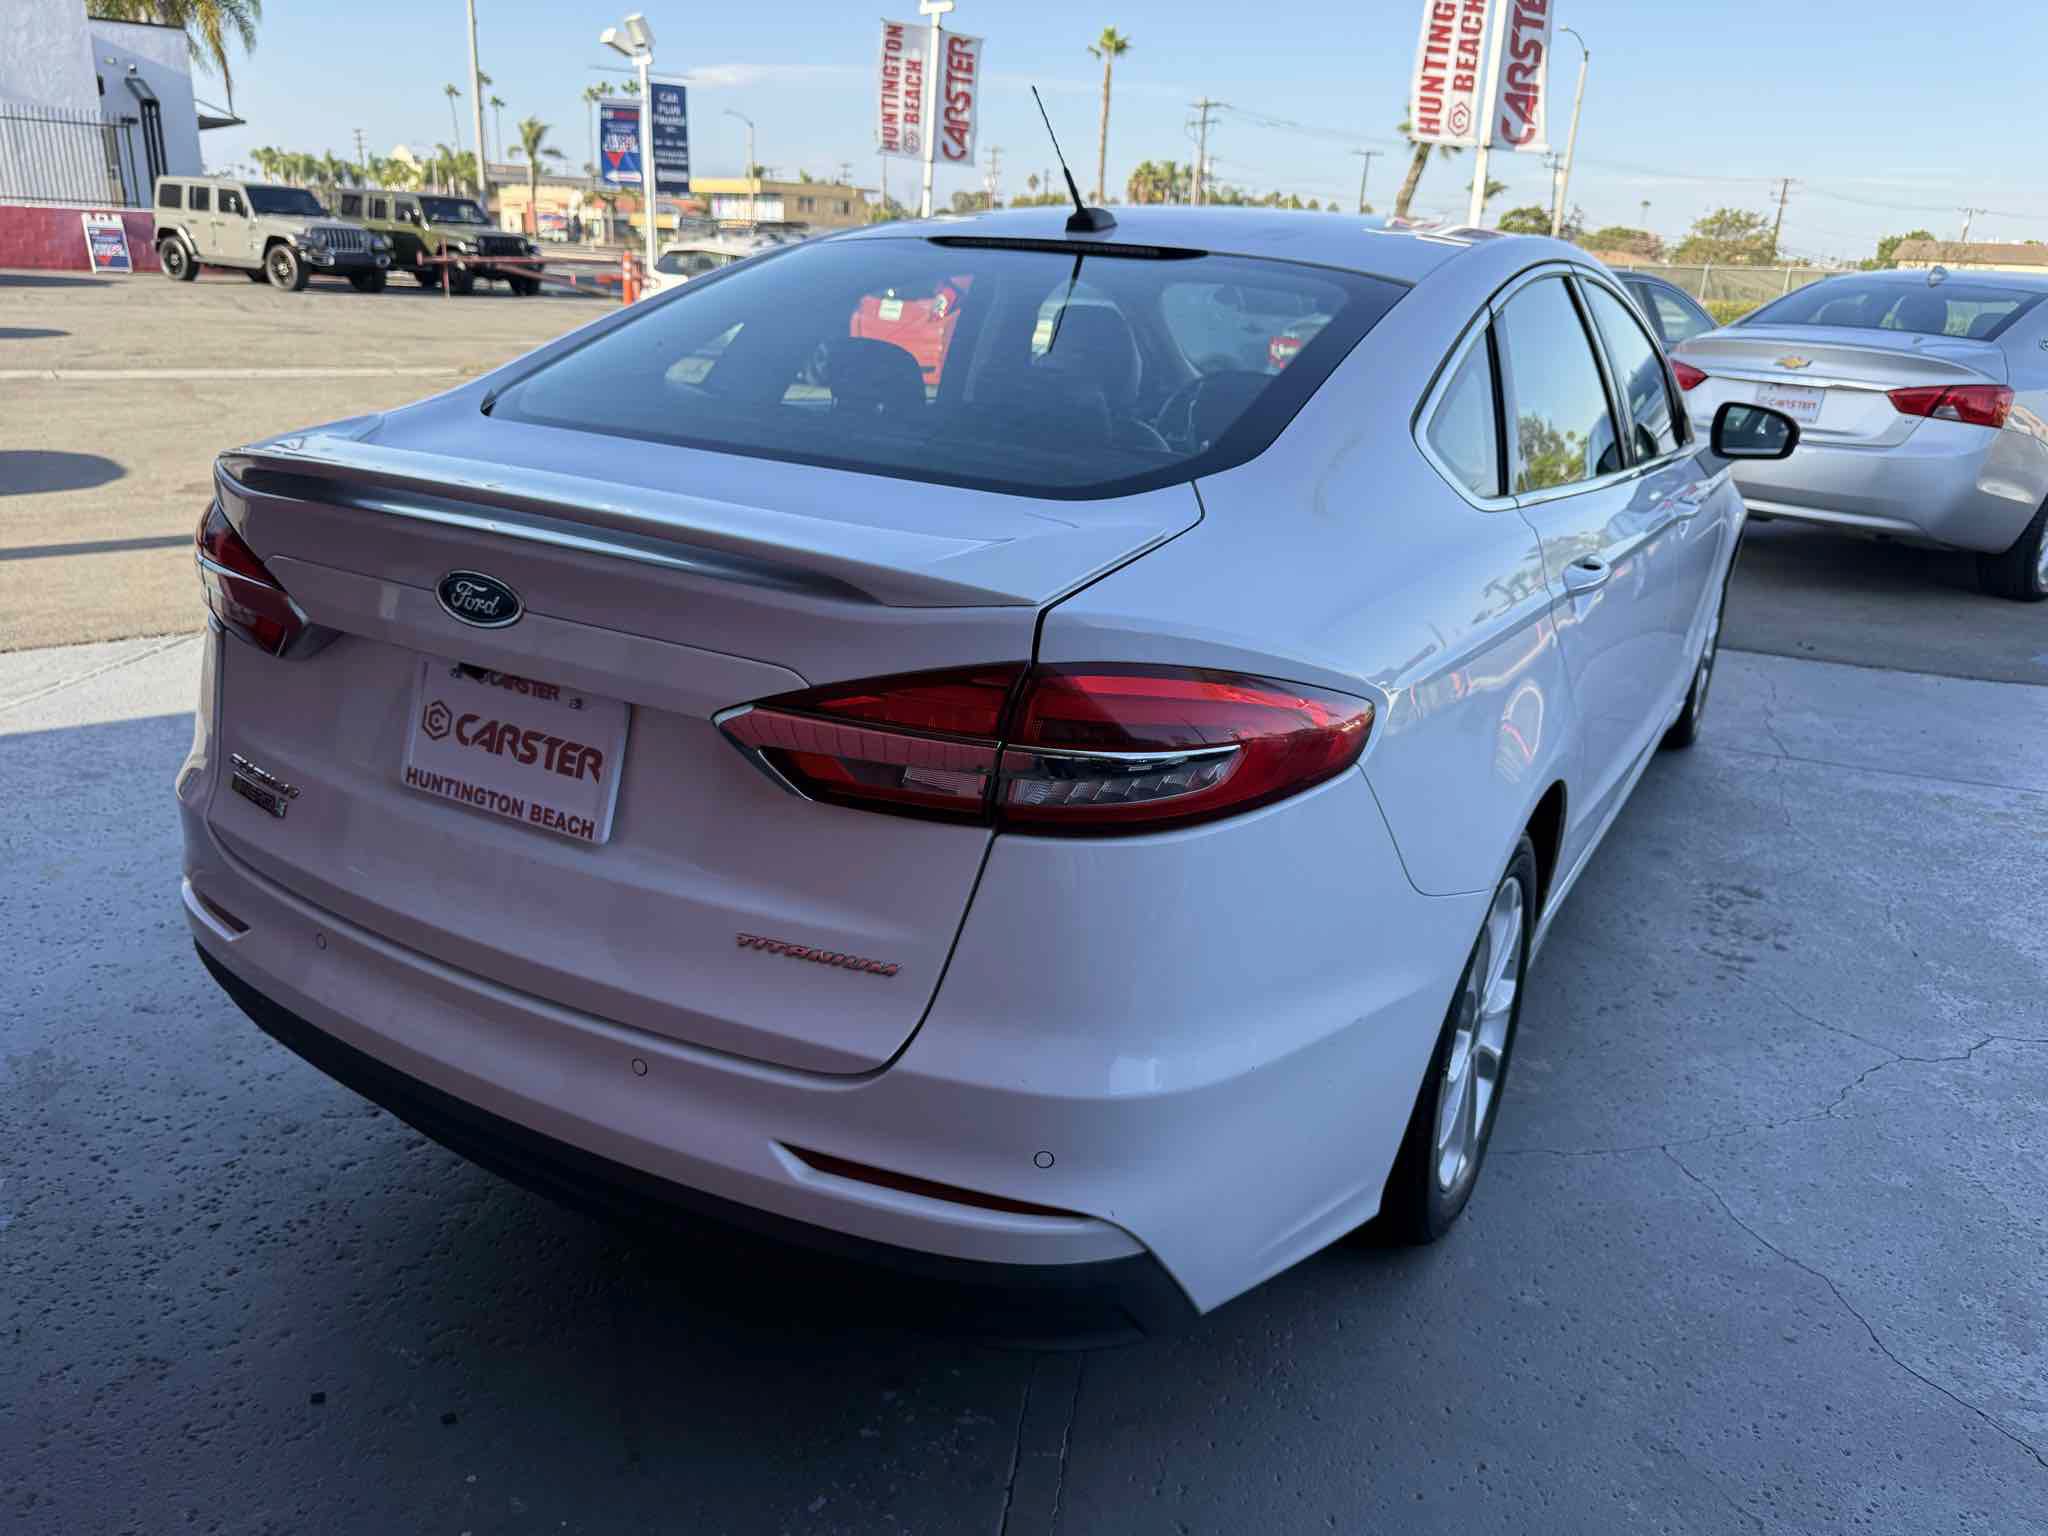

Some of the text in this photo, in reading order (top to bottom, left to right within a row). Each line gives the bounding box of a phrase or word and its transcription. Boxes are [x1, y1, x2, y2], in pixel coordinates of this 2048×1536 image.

[881, 24, 904, 152] HUNTINGTON
[903, 58, 923, 125] BEACH
[943, 36, 975, 161] CARSTER
[451, 580, 500, 617] Ford
[455, 713, 604, 784] CARSTER
[405, 766, 596, 841] HUNTINGTON BEACH
